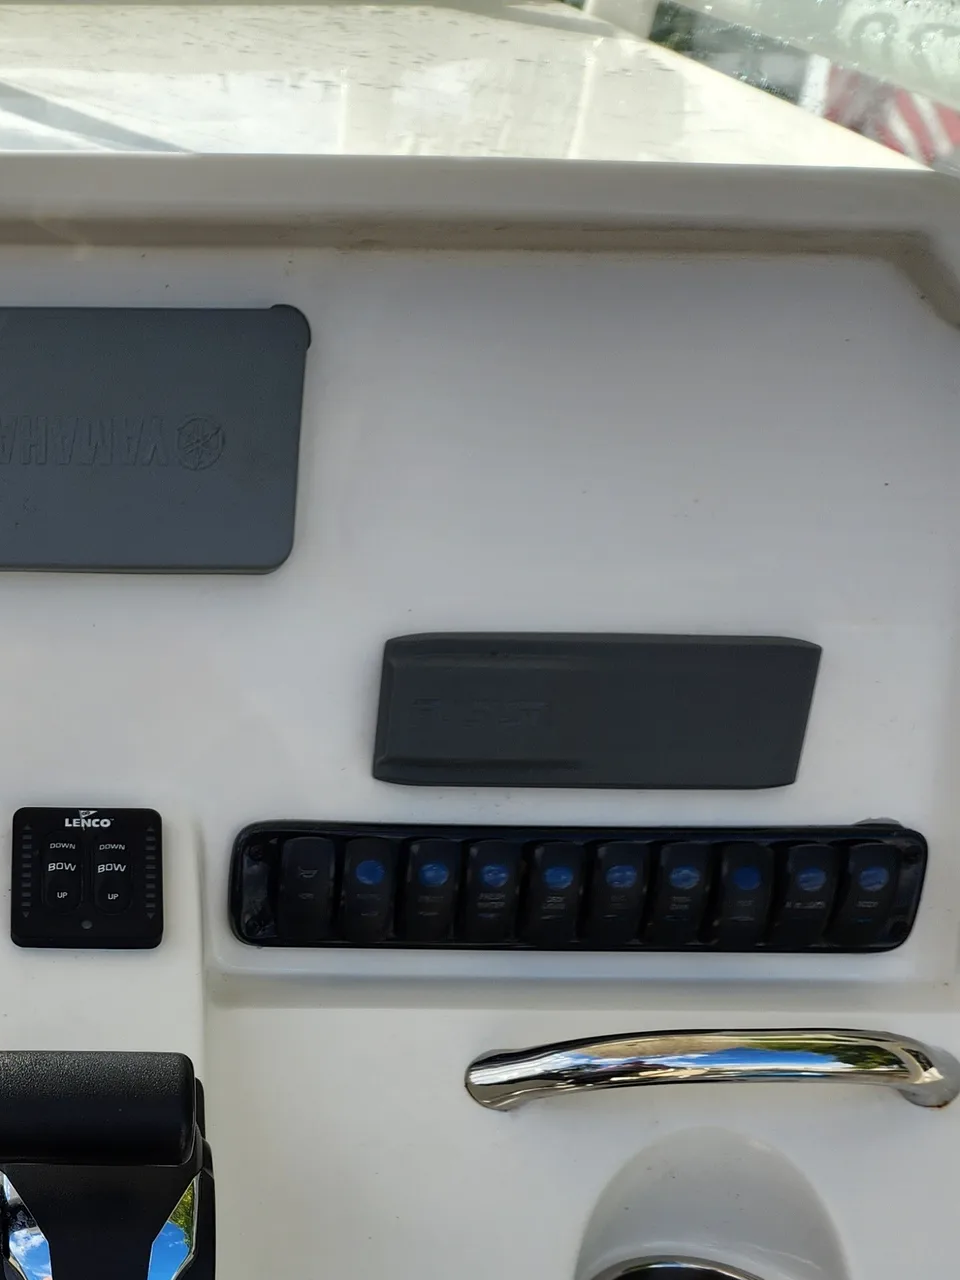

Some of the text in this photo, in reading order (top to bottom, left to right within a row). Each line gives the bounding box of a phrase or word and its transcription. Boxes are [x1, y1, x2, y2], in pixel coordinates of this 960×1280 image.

[64, 817, 112, 828] LENCO
[49, 842, 76, 850] DOWN
[99, 843, 126, 851] DOWN
[47, 862, 77, 872] BOW
[97, 863, 127, 873] BOW
[56, 891, 68, 899] UP
